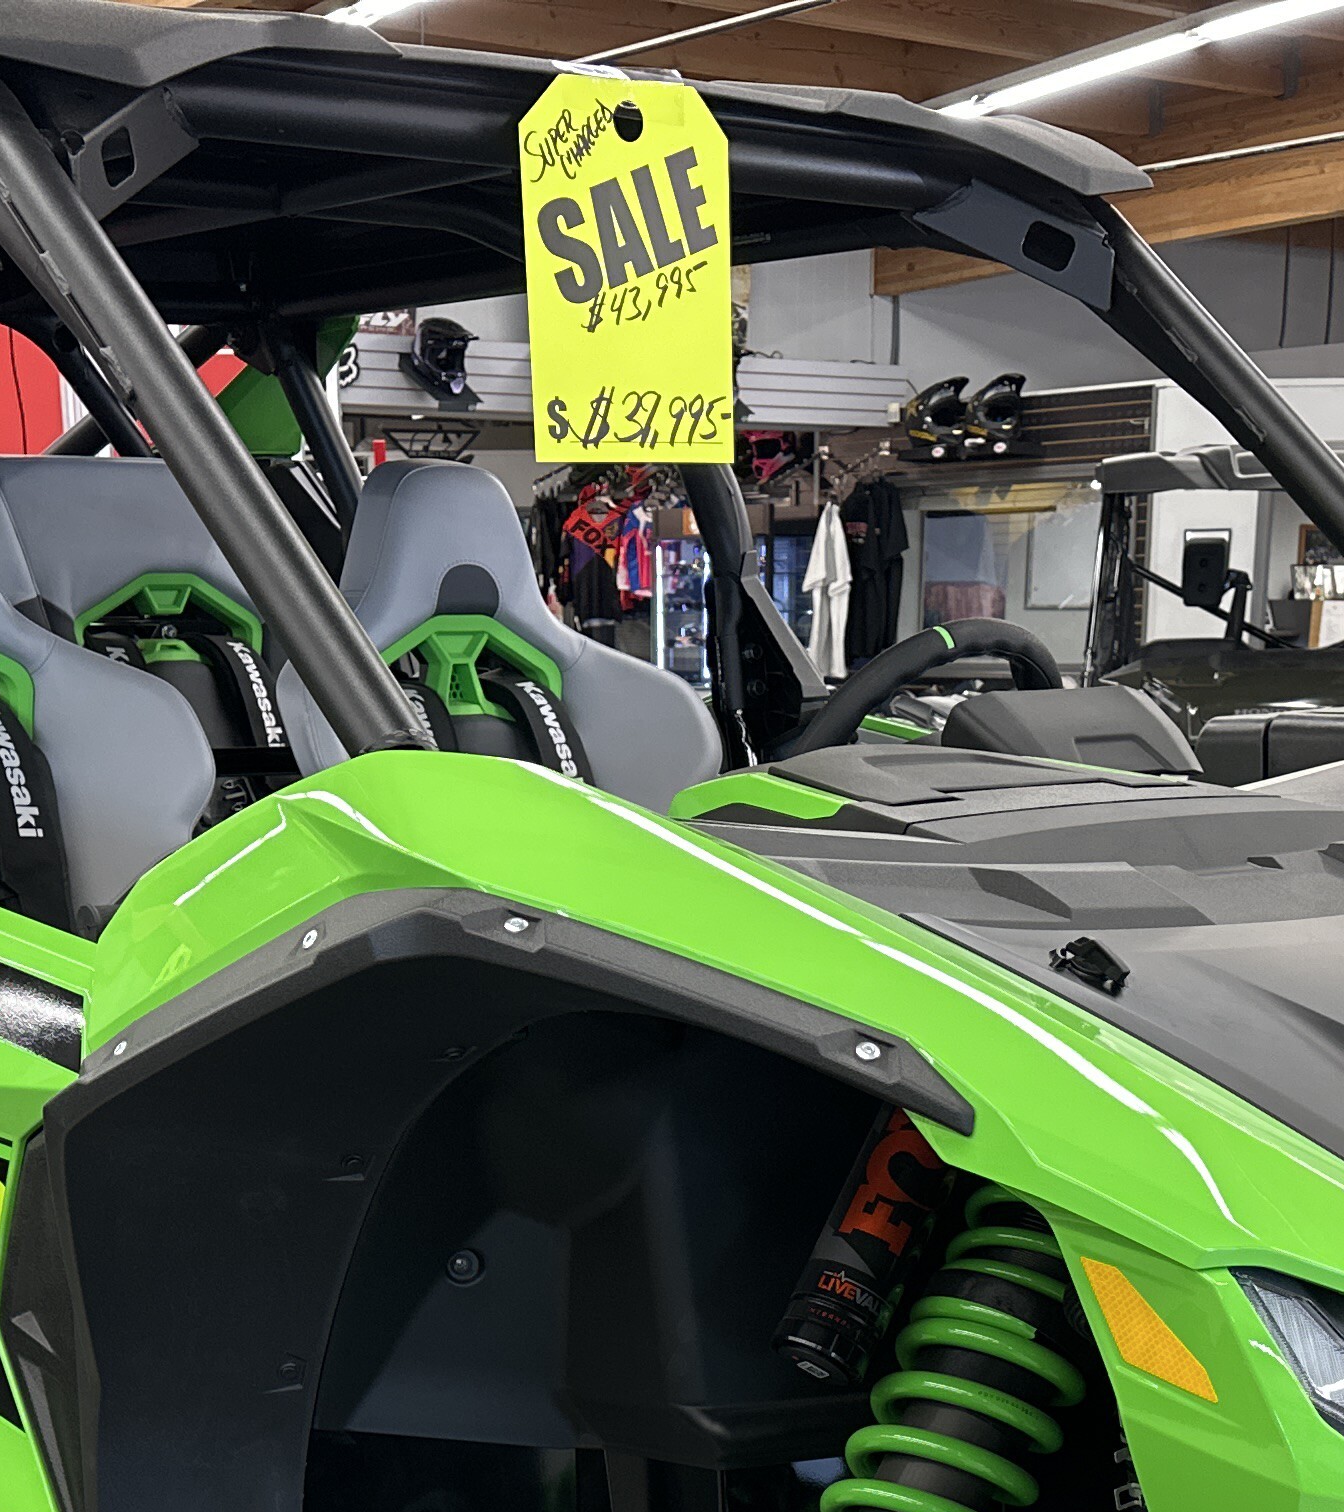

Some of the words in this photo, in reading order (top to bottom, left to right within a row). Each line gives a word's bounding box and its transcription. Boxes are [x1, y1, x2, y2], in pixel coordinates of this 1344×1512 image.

[524, 109, 578, 183] SUPER
[537, 146, 718, 304] SALE
[227, 641, 285, 748] Kawasaki
[516, 681, 585, 784] Kawasa
